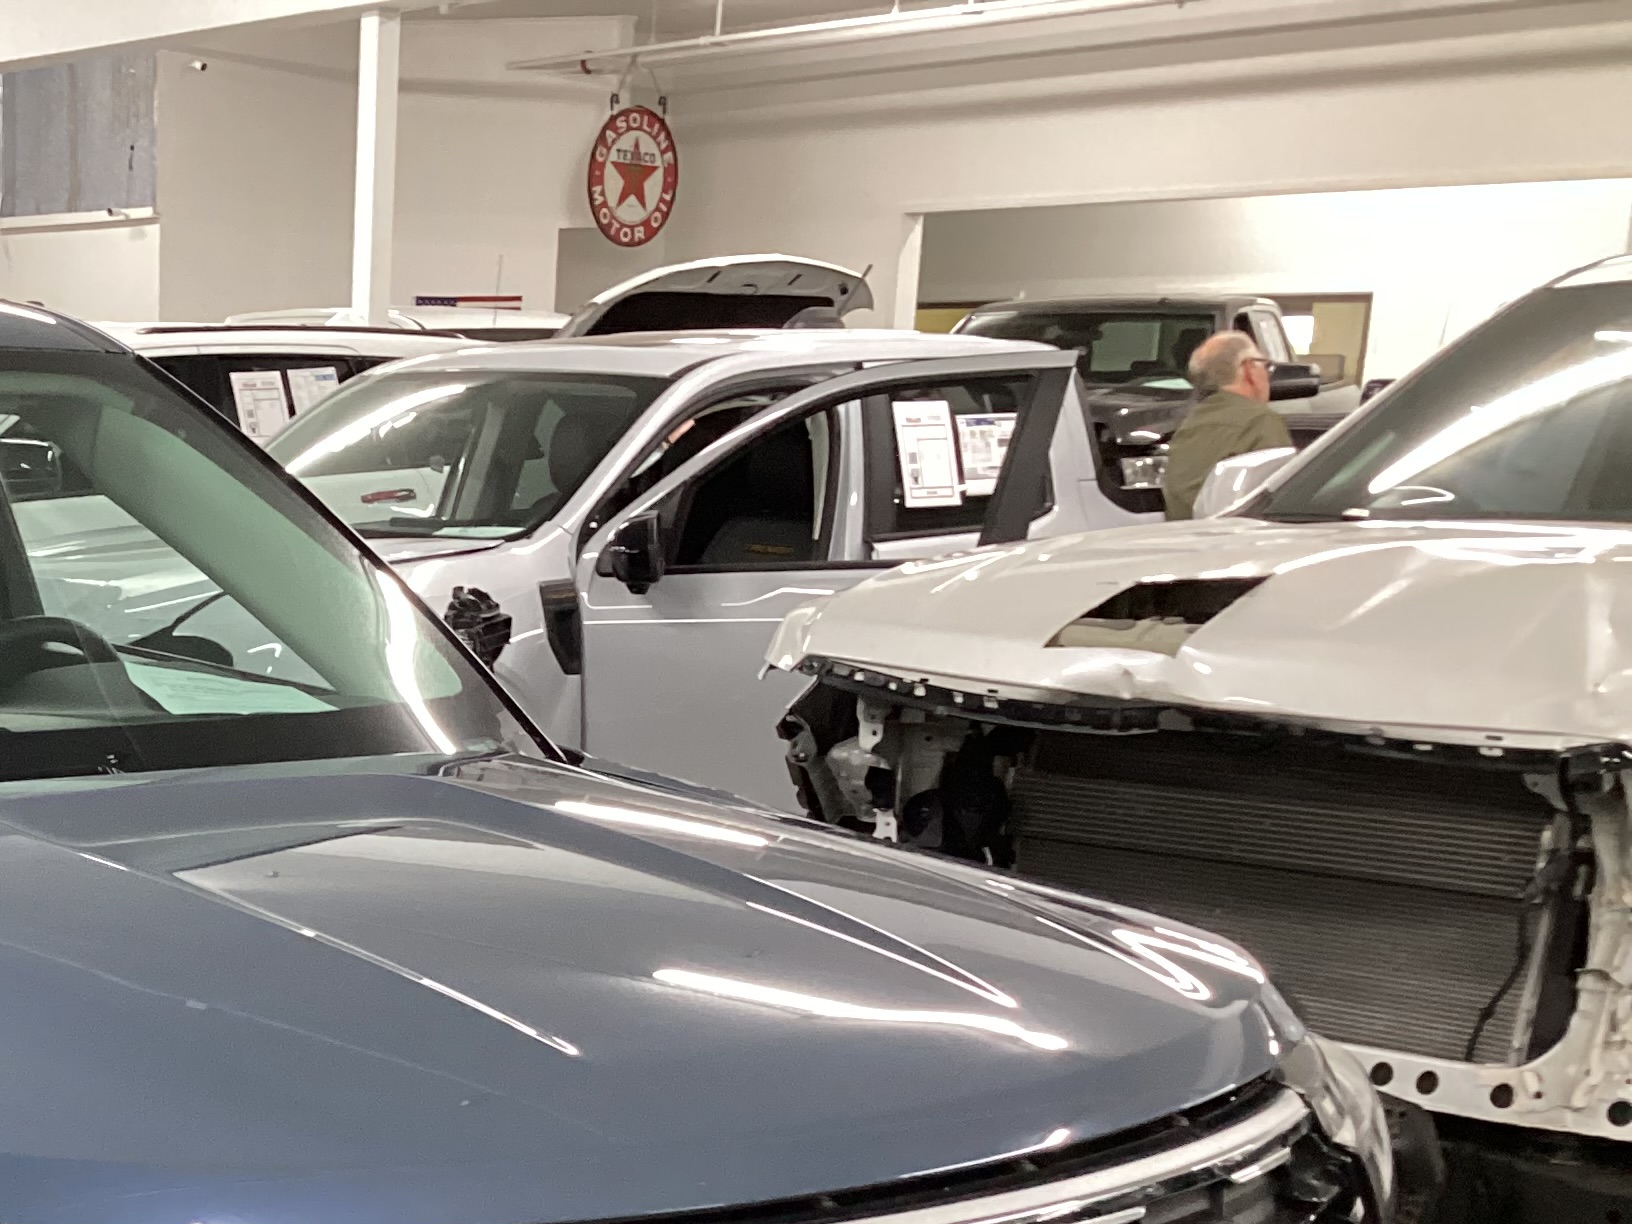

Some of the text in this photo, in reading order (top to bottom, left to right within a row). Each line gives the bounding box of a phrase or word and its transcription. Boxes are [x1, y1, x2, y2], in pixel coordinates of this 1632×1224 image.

[596, 112, 675, 167] GASOLINE
[592, 185, 673, 242] MOTOR OIL
